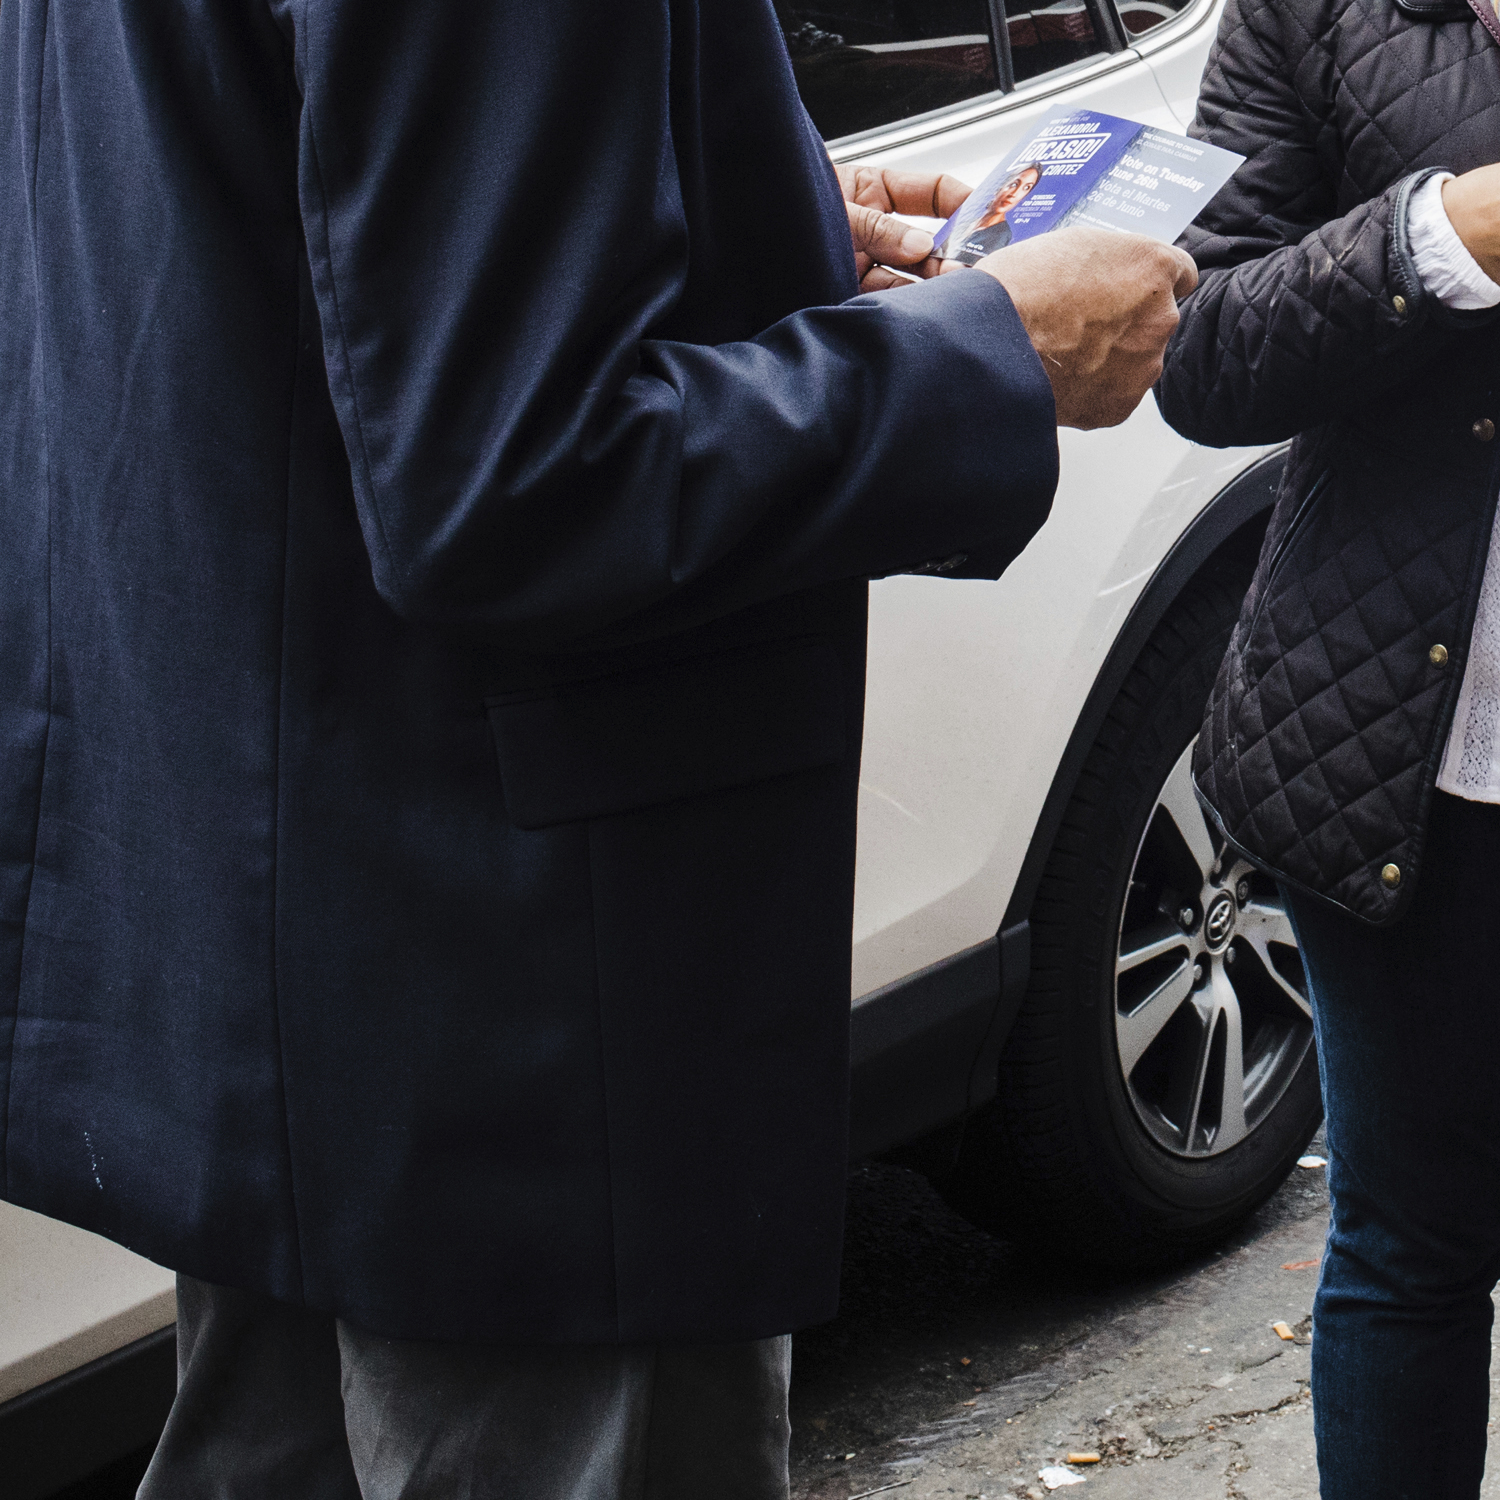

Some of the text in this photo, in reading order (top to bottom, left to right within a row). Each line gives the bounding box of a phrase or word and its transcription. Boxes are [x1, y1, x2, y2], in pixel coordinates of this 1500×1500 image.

[1037, 122, 1101, 137] ALEXANDRIA
[1042, 164, 1085, 176] CORTEZ
[1108, 166, 1159, 190] June 26th
[1120, 154, 1205, 193] Vote on Tuesday
[1087, 190, 1145, 218] 26 de Junio
[1099, 179, 1171, 212] Vota el Martes
